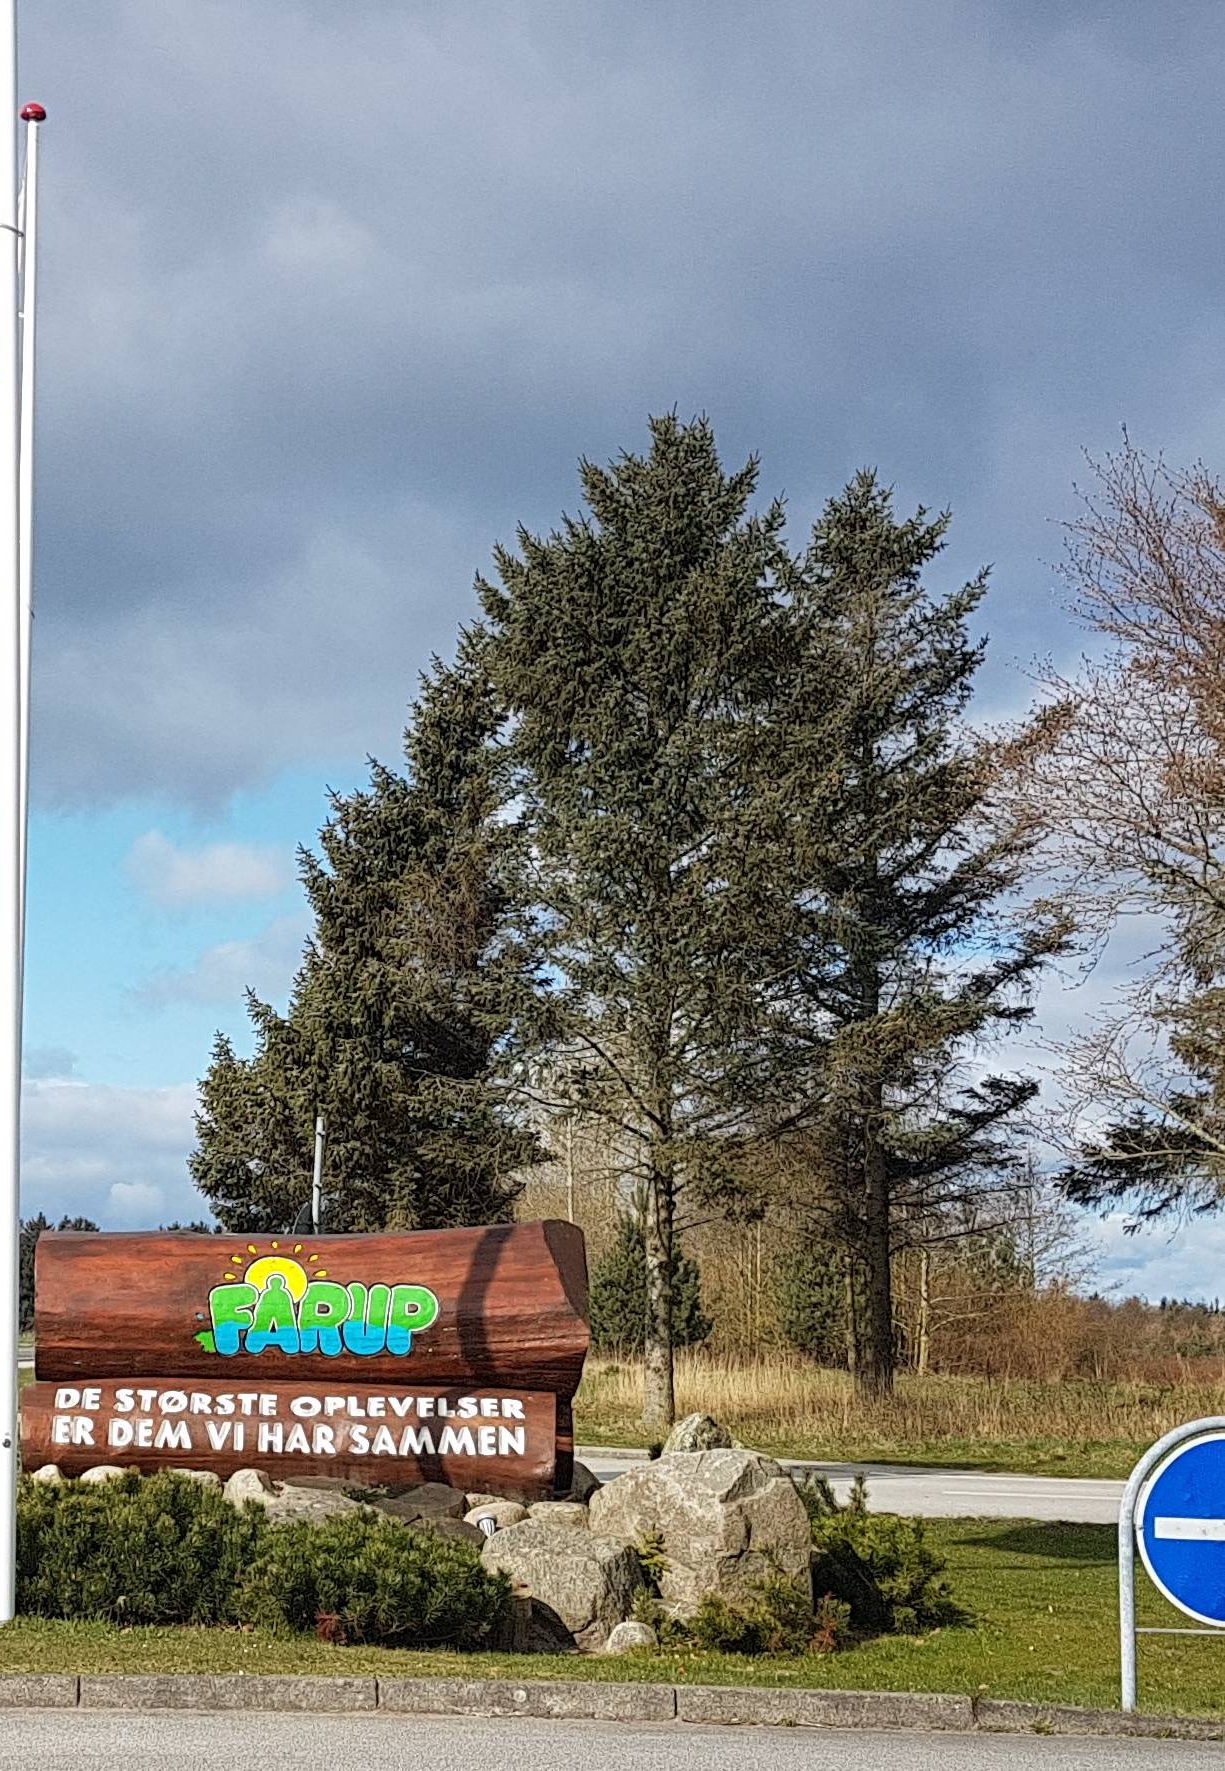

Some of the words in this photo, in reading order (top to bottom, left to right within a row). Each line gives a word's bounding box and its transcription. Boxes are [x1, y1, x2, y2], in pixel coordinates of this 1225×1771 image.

[209, 1273, 440, 1357] FÅRUP
[55, 1388, 102, 1410] DE
[113, 1388, 278, 1416] STØRSTE
[290, 1395, 526, 1419] OPLEVELSER
[52, 1415, 95, 1446] ER
[108, 1417, 192, 1449] DEM
[205, 1421, 244, 1451] VI
[257, 1421, 336, 1454] HAR
[348, 1424, 525, 1456] SAMMEN
